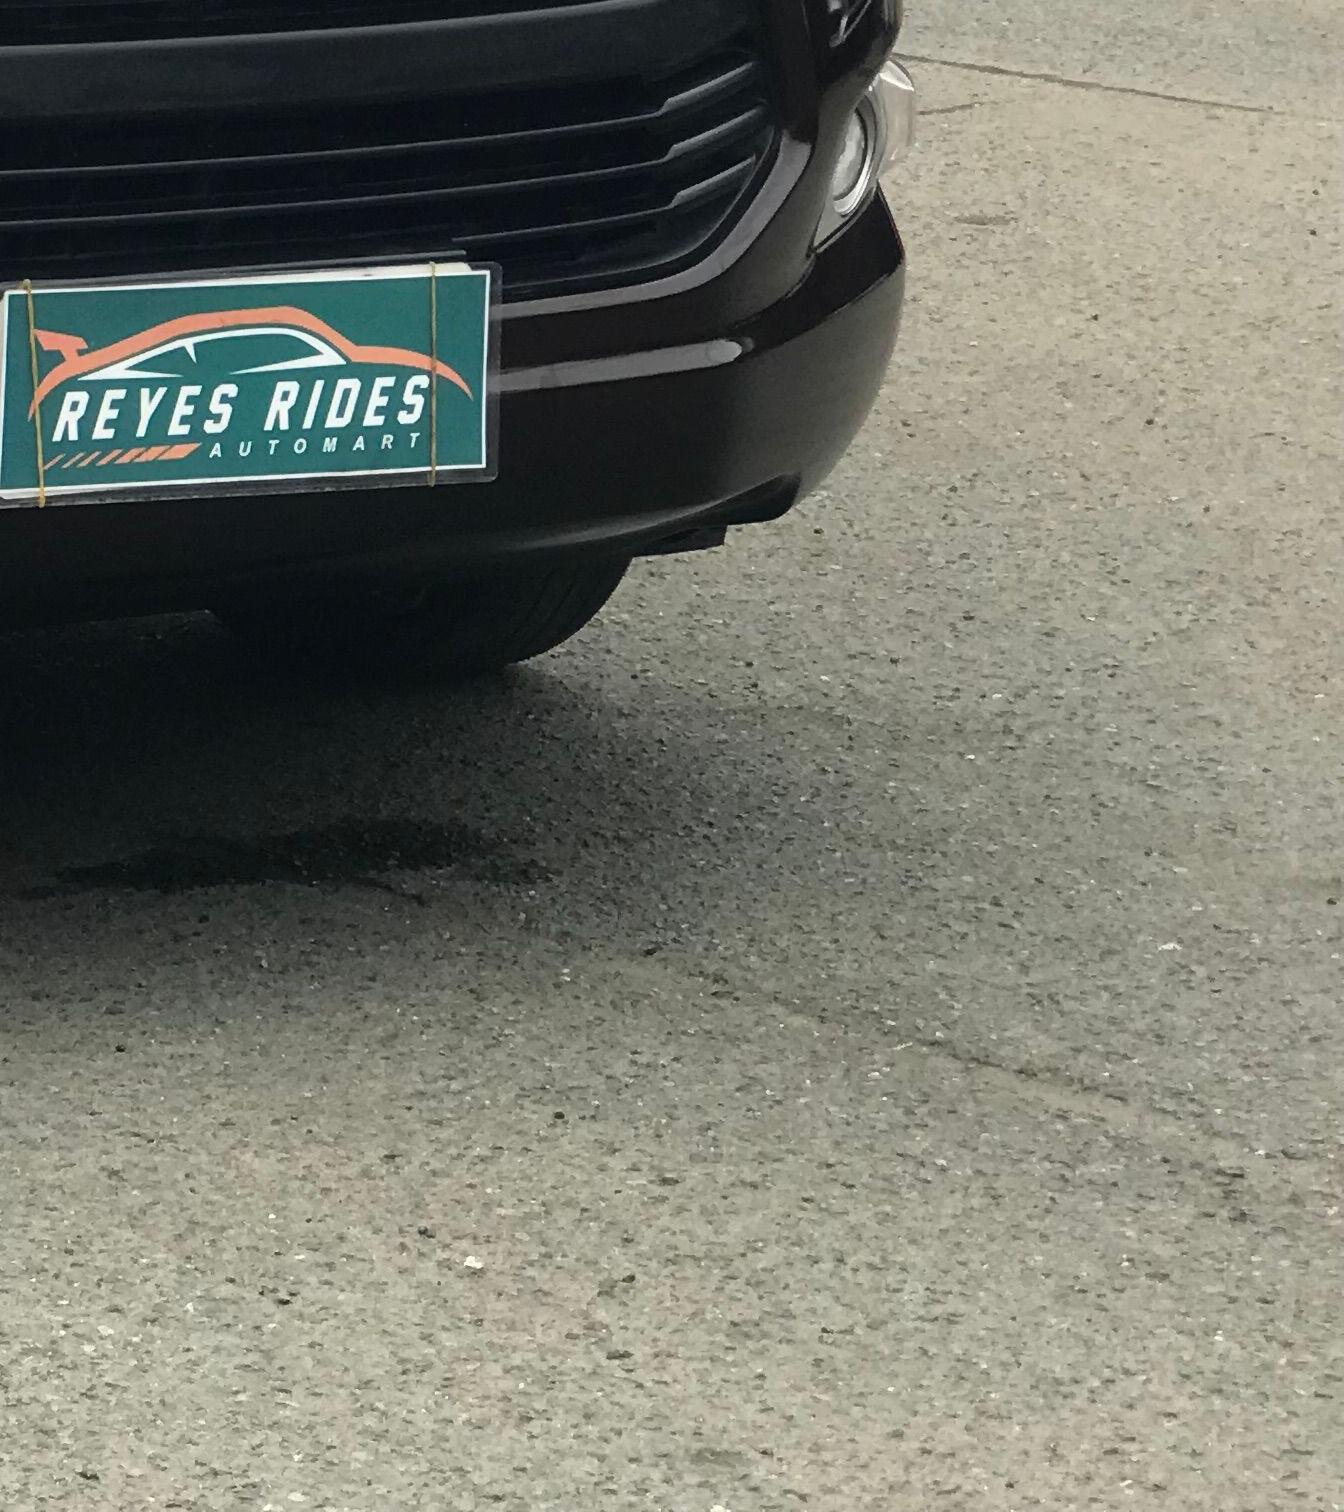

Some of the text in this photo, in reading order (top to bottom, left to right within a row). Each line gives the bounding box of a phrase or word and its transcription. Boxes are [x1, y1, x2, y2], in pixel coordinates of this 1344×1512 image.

[51, 372, 432, 443] REYES RIDES
[208, 431, 423, 459] AUTOMART
